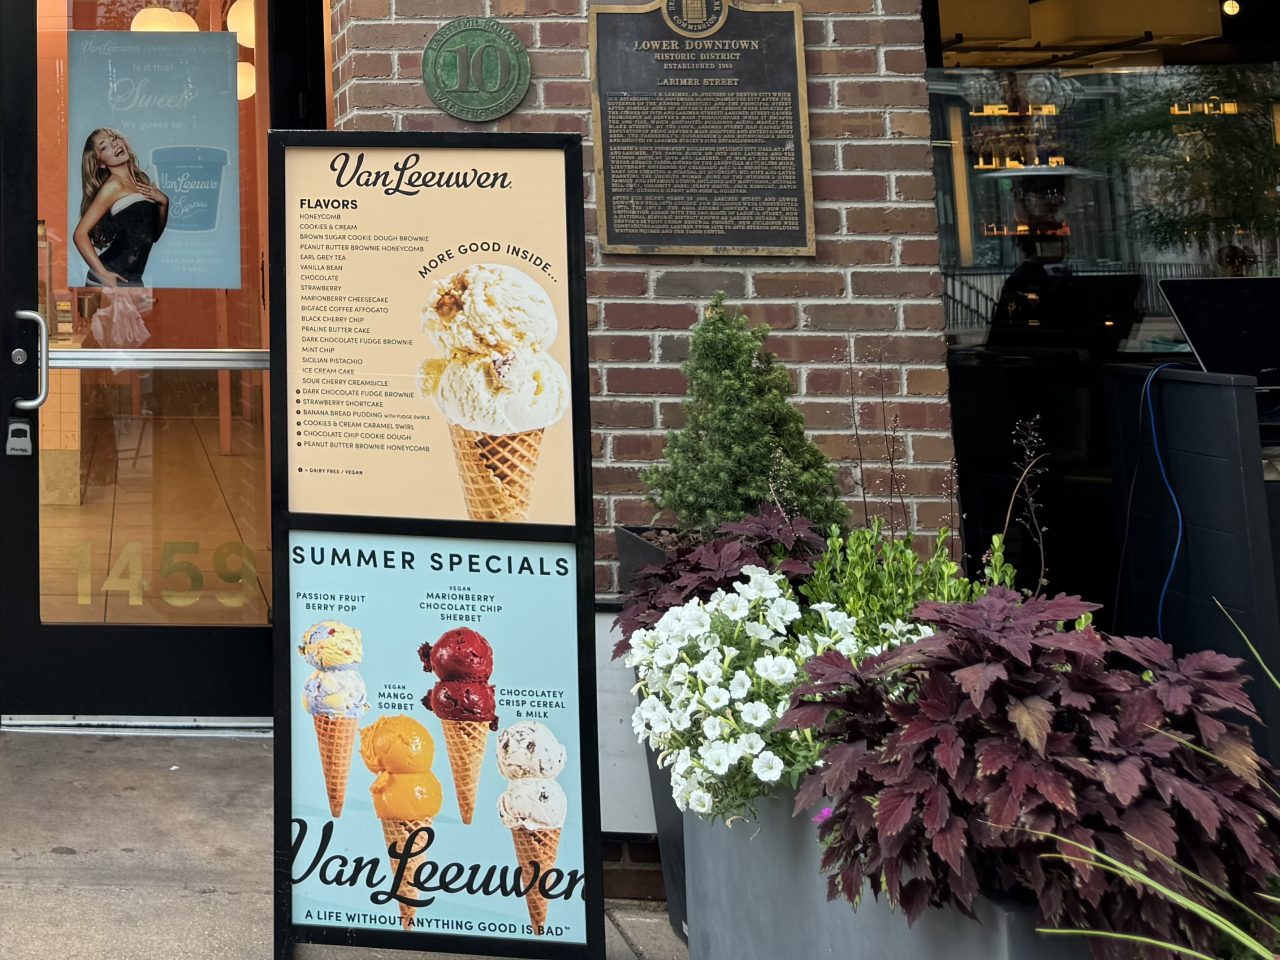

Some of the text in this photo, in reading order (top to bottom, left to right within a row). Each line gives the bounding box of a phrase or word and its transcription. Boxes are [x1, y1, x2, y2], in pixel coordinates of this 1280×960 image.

[673, 15, 717, 30] COMMISSION
[634, 40, 759, 50] LOWER DOWNTOWN
[439, 43, 511, 93] 10
[657, 78, 739, 86] LARIMER STREET
[300, 199, 358, 209] FLAVORS
[417, 247, 456, 279] MORE
[457, 241, 501, 255] GOOD
[292, 545, 570, 576] SUMMER SPECIALS
[67, 541, 257, 607] 1459
[296, 592, 366, 603] PASSION FRUIT
[426, 592, 495, 602] MARIONBERRY
[306, 603, 357, 612] BERRY POP
[419, 602, 503, 613] CHOCOLATE CHIP
[440, 614, 482, 622] SHERBET
[378, 691, 414, 700] MANGO
[499, 688, 564, 699] CHOCOLATEY
[378, 701, 414, 711] SORBET
[498, 699, 566, 709] CRISP CEREAL
[516, 710, 549, 719] & MILK
[305, 910, 313, 919] A
[317, 910, 342, 922] LIFE
[346, 913, 404, 927] WITHOUT
[407, 917, 473, 931] ANYTHING
[478, 922, 517, 934] GOOD
[521, 924, 533, 935] IS
